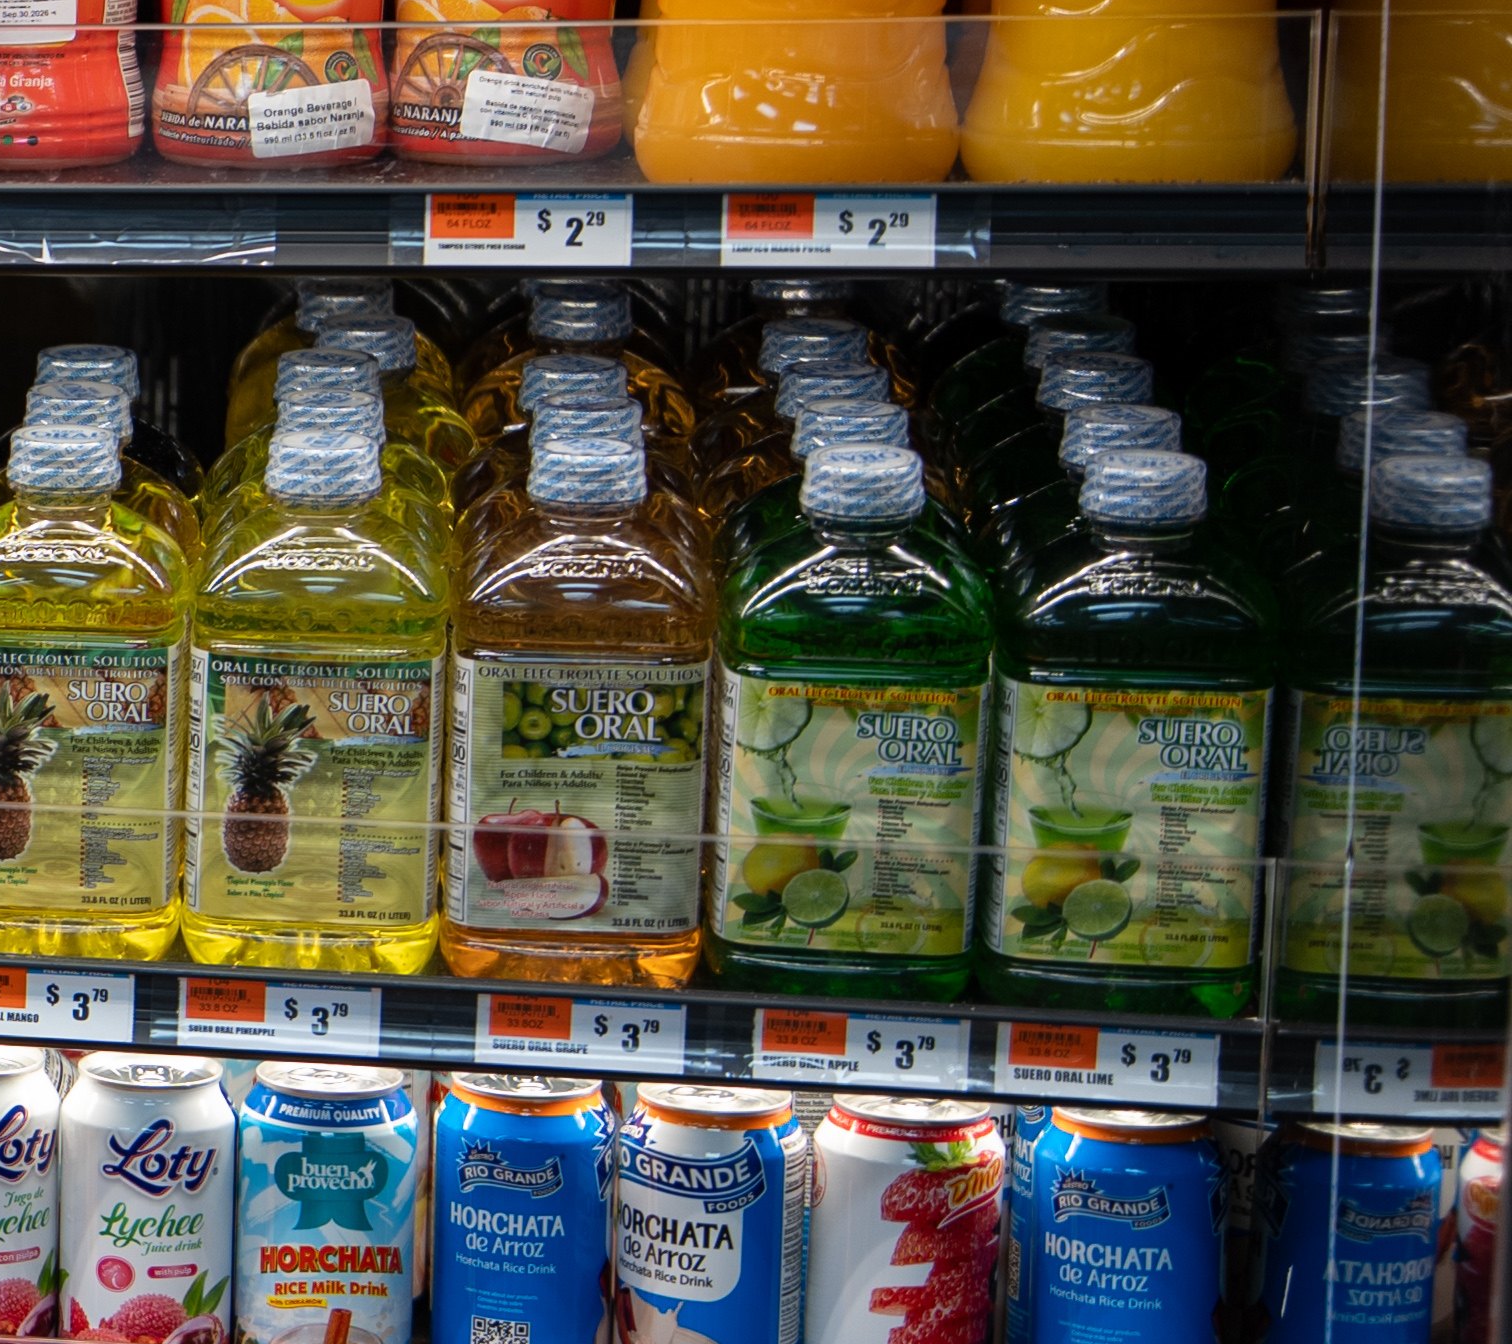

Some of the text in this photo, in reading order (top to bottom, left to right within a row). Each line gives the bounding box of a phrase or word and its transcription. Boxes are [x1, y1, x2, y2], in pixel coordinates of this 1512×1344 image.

[552, 688, 655, 715] SUERO
[575, 717, 661, 742] ORAL
[1012, 1068, 1110, 1086] SUERO ORAL LIME
[102, 1120, 217, 1194] Loty
[302, 1158, 350, 1178] buen
[287, 1172, 372, 1190] provecho
[464, 1164, 555, 1184] RIO GRANDE
[100, 1202, 203, 1248] Lychee
[452, 1203, 564, 1236] HORCHATA
[142, 1237, 203, 1256] Juice drink
[260, 1247, 403, 1275] HORCHATA
[275, 1281, 388, 1298] RICE Milk Drink
